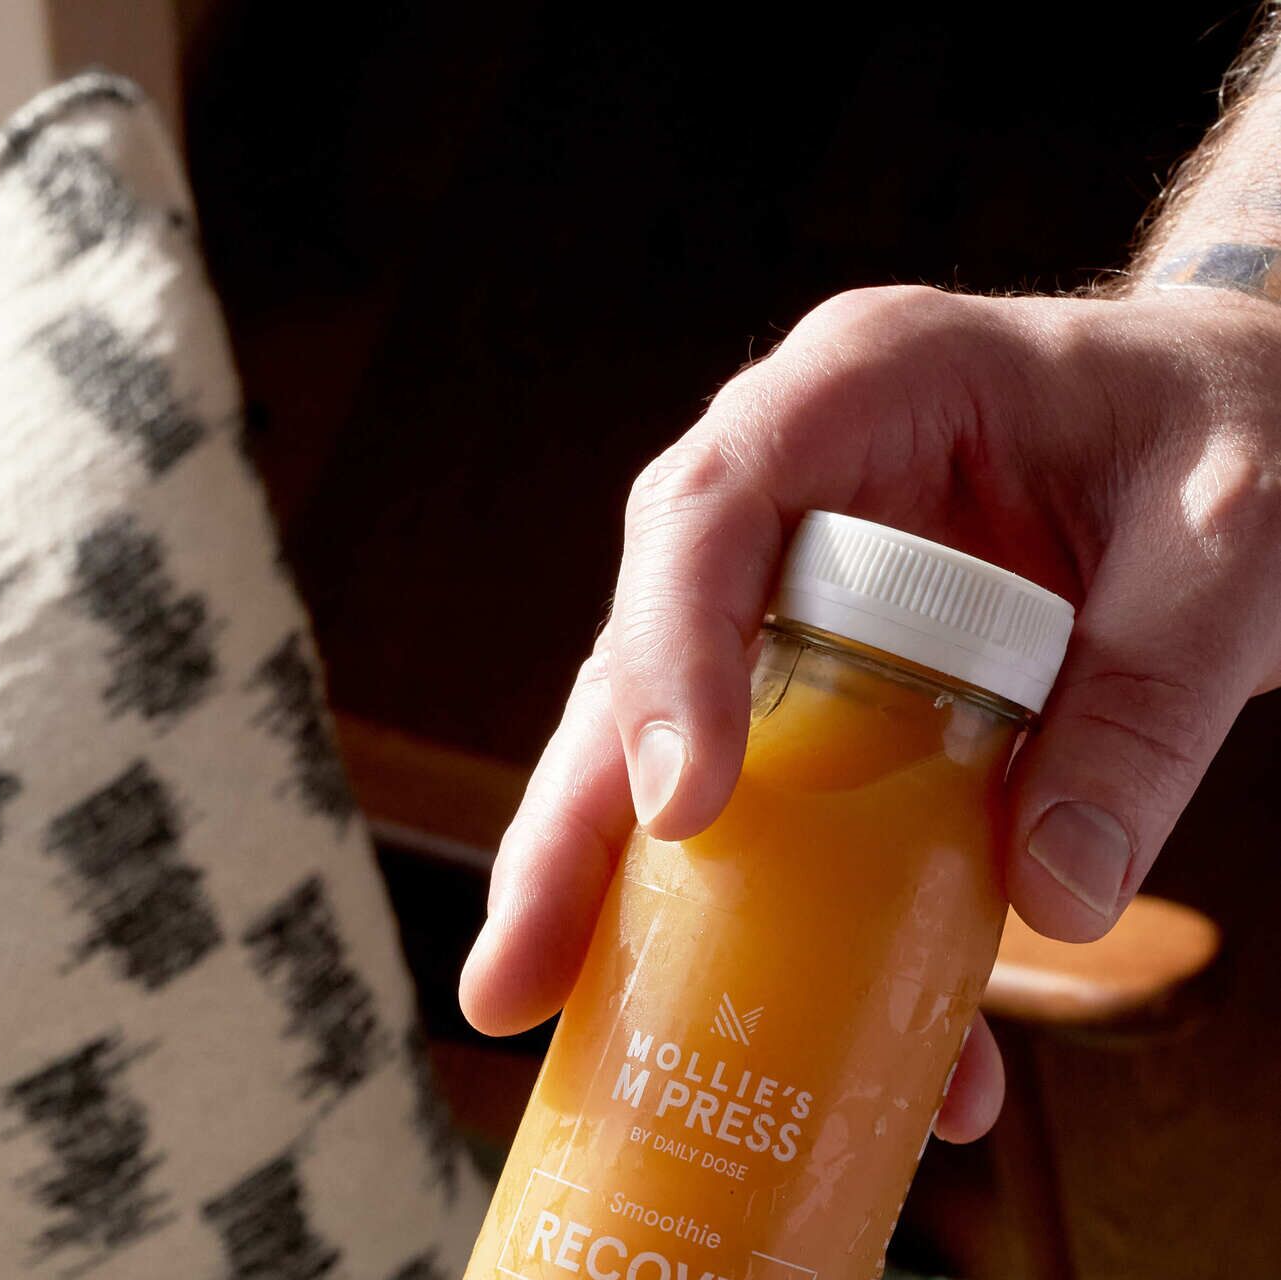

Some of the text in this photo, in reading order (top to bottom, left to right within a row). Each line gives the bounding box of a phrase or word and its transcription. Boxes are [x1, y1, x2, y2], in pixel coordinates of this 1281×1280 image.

[626, 1030, 813, 1117] MOLLIE'S
[611, 1064, 804, 1162] M PRESS
[629, 1126, 748, 1181] BY DAILY DOSE
[609, 1191, 722, 1249] Smoothie
